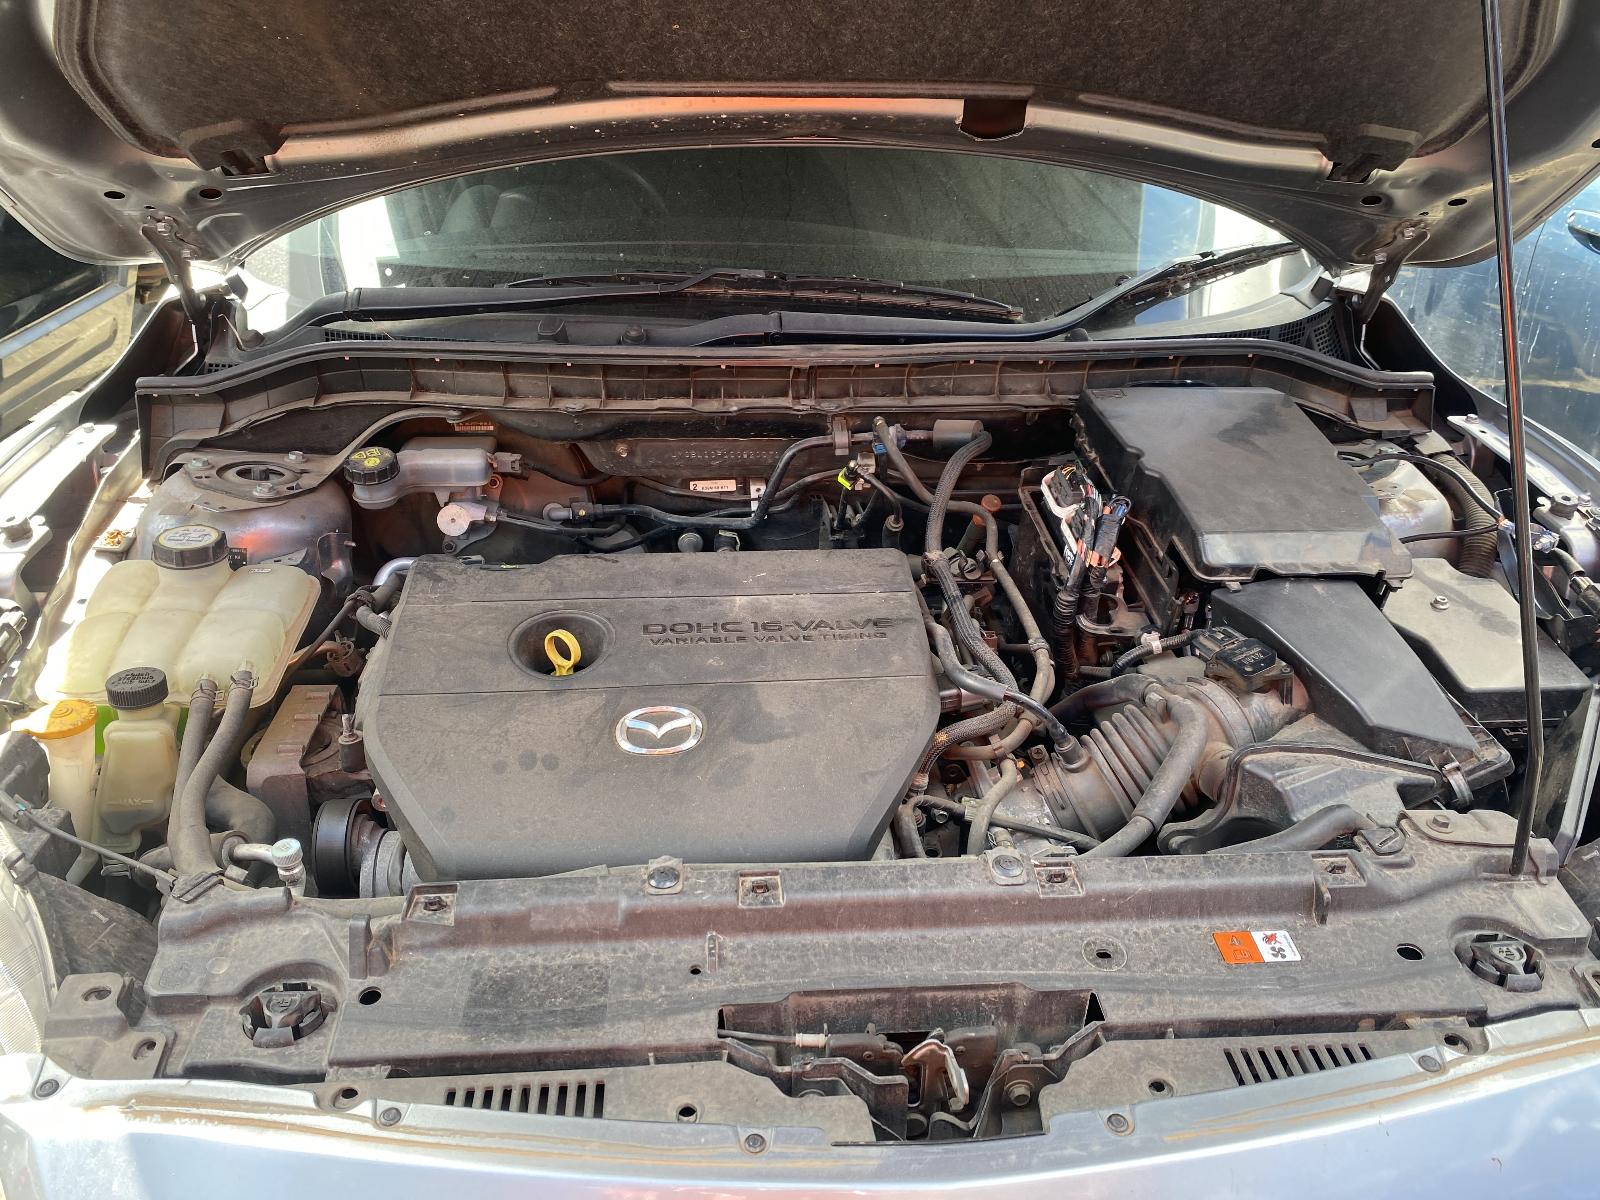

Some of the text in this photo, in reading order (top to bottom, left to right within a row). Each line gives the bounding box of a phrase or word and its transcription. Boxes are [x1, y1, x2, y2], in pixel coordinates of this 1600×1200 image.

[692, 483, 698, 491] 2
[641, 617, 895, 635] DOHC 16-VALVE
[649, 631, 888, 646] VARIABLE VALVE TIMING
